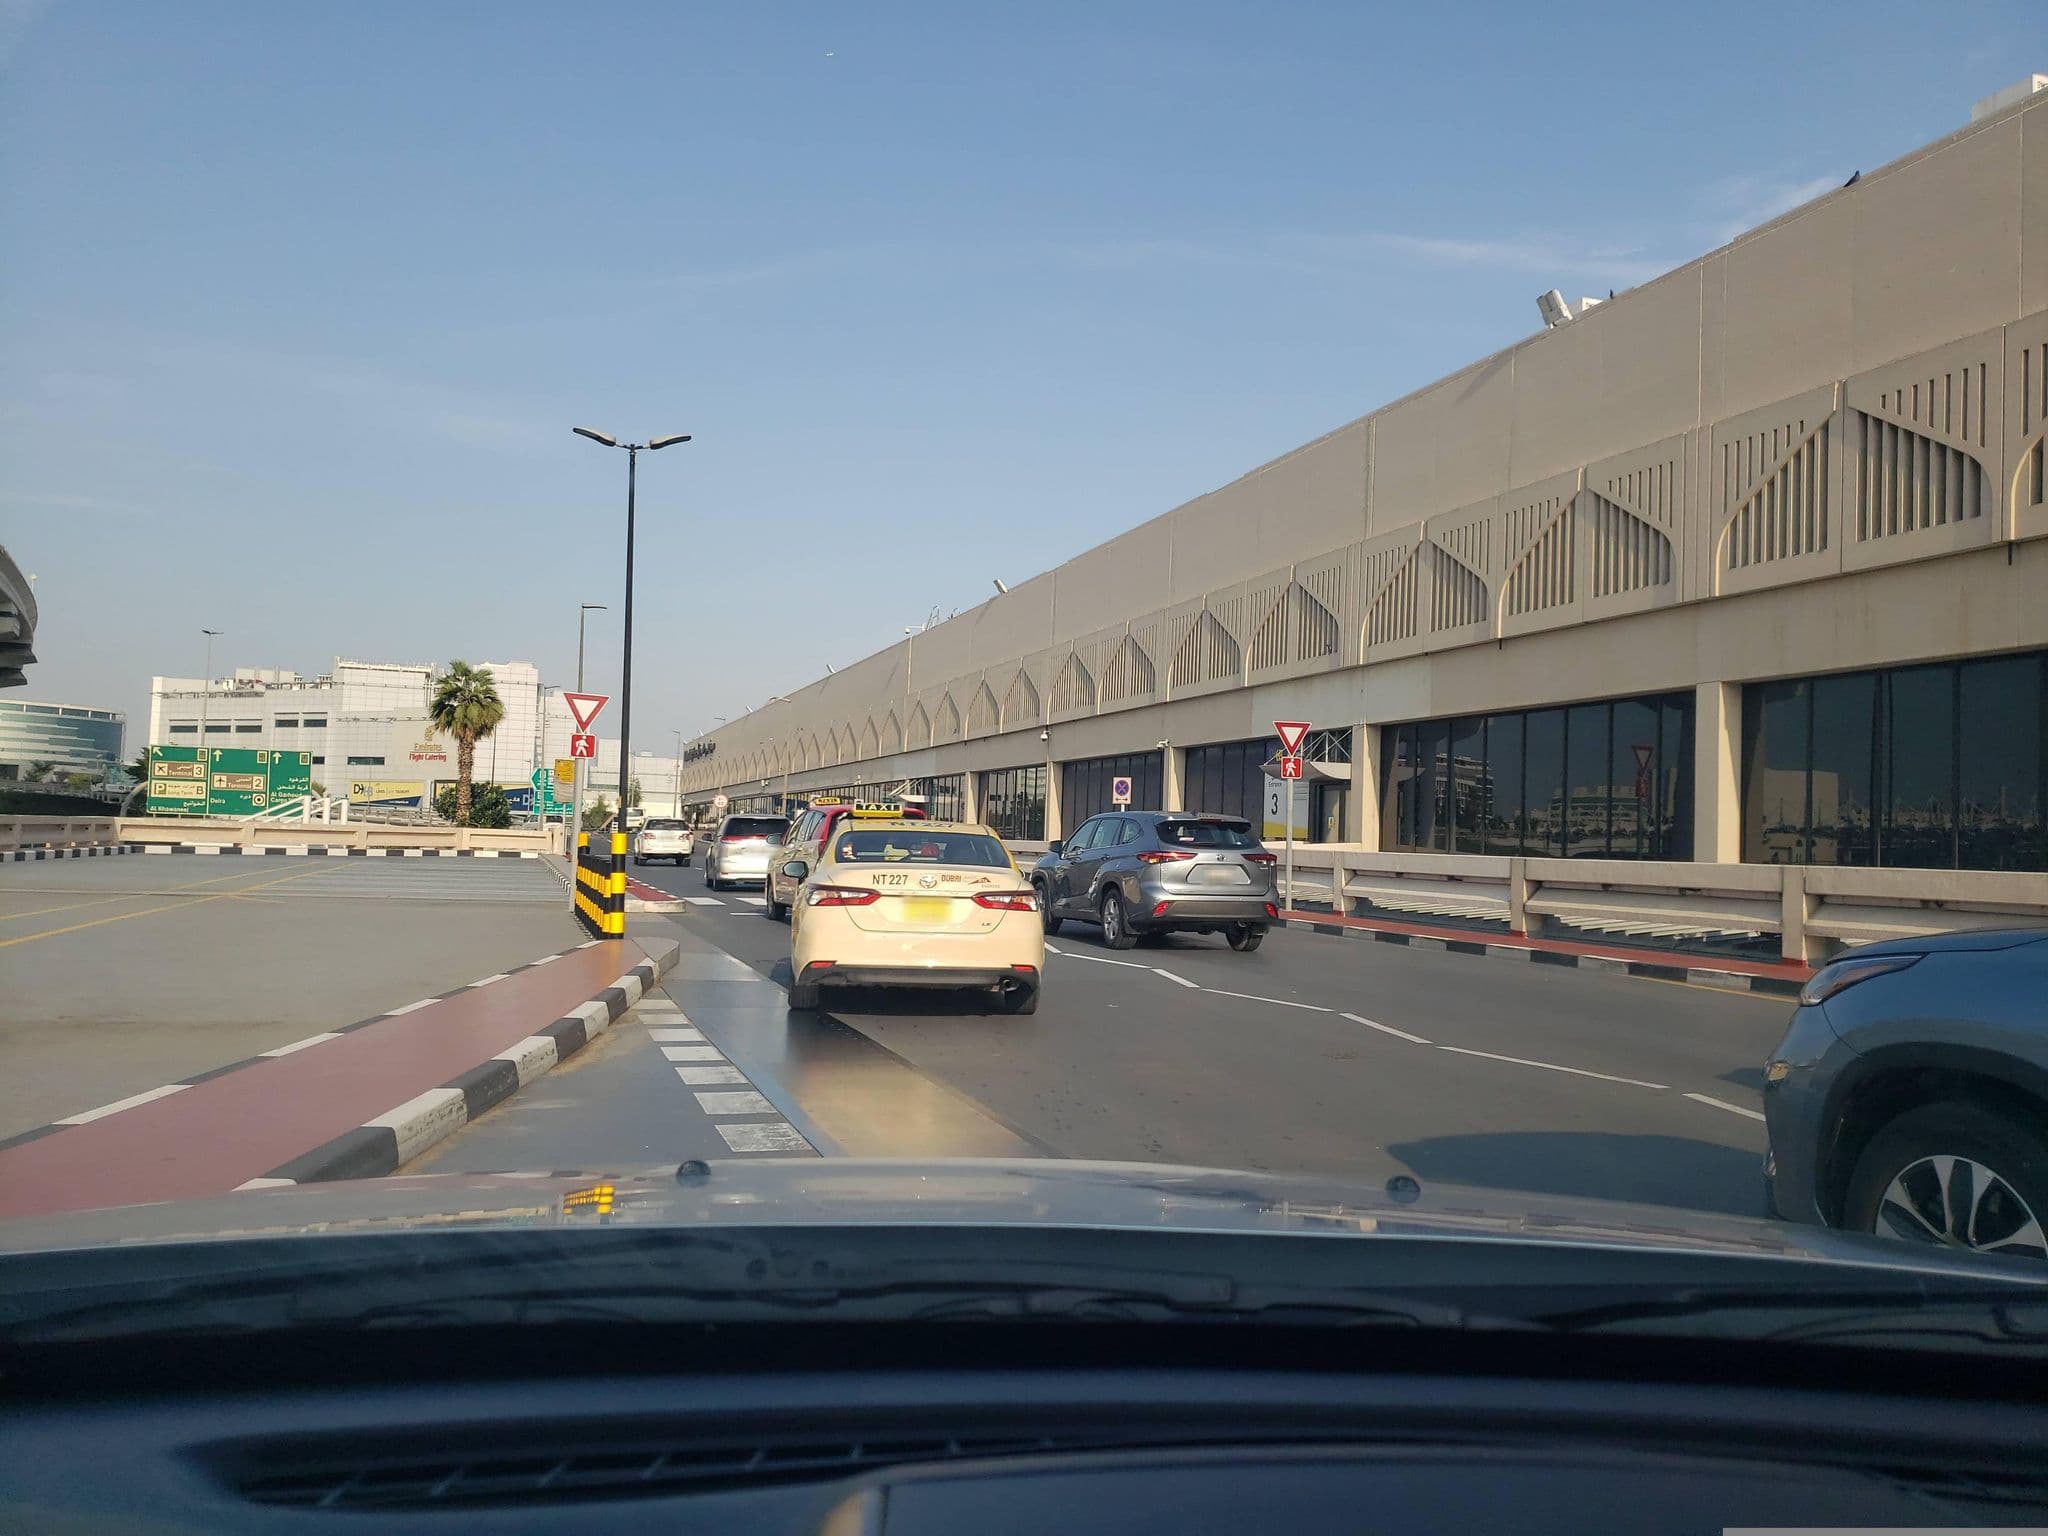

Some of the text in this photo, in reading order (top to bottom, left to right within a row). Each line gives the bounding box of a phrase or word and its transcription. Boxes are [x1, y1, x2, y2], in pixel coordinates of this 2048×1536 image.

[409, 753, 447, 762] Flight Catering
[195, 766, 202, 776] 3
[254, 778, 262, 788] 2
[196, 785, 204, 795] B
[861, 803, 895, 811] TAXI
[1271, 793, 1278, 815] 3
[872, 874, 908, 885] NT 227
